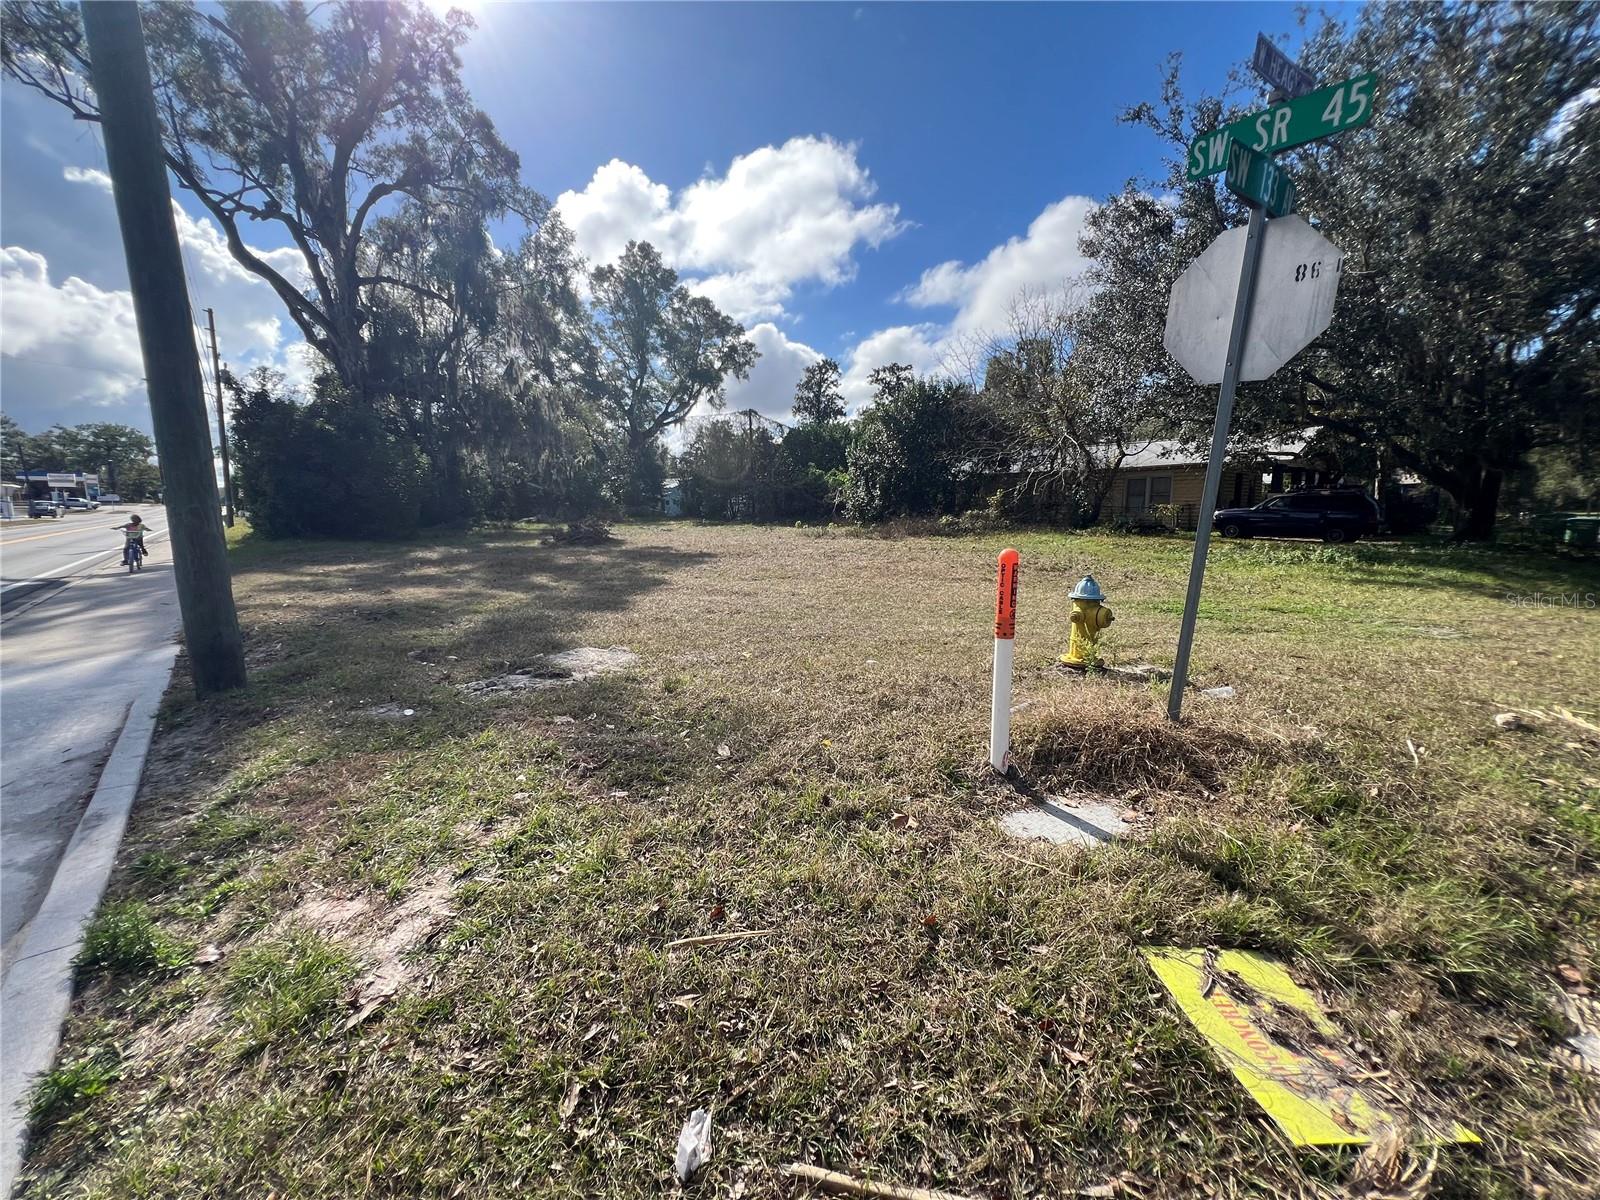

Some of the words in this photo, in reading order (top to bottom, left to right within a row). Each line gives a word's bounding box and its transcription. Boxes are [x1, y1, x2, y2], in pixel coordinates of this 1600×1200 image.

[1191, 131, 1229, 175] SW
[1252, 107, 1292, 152] SR
[1321, 79, 1369, 127] 45
[1228, 143, 1252, 189] SW
[1295, 261, 1321, 282] 86
[1210, 991, 1278, 1062] CONCRET
